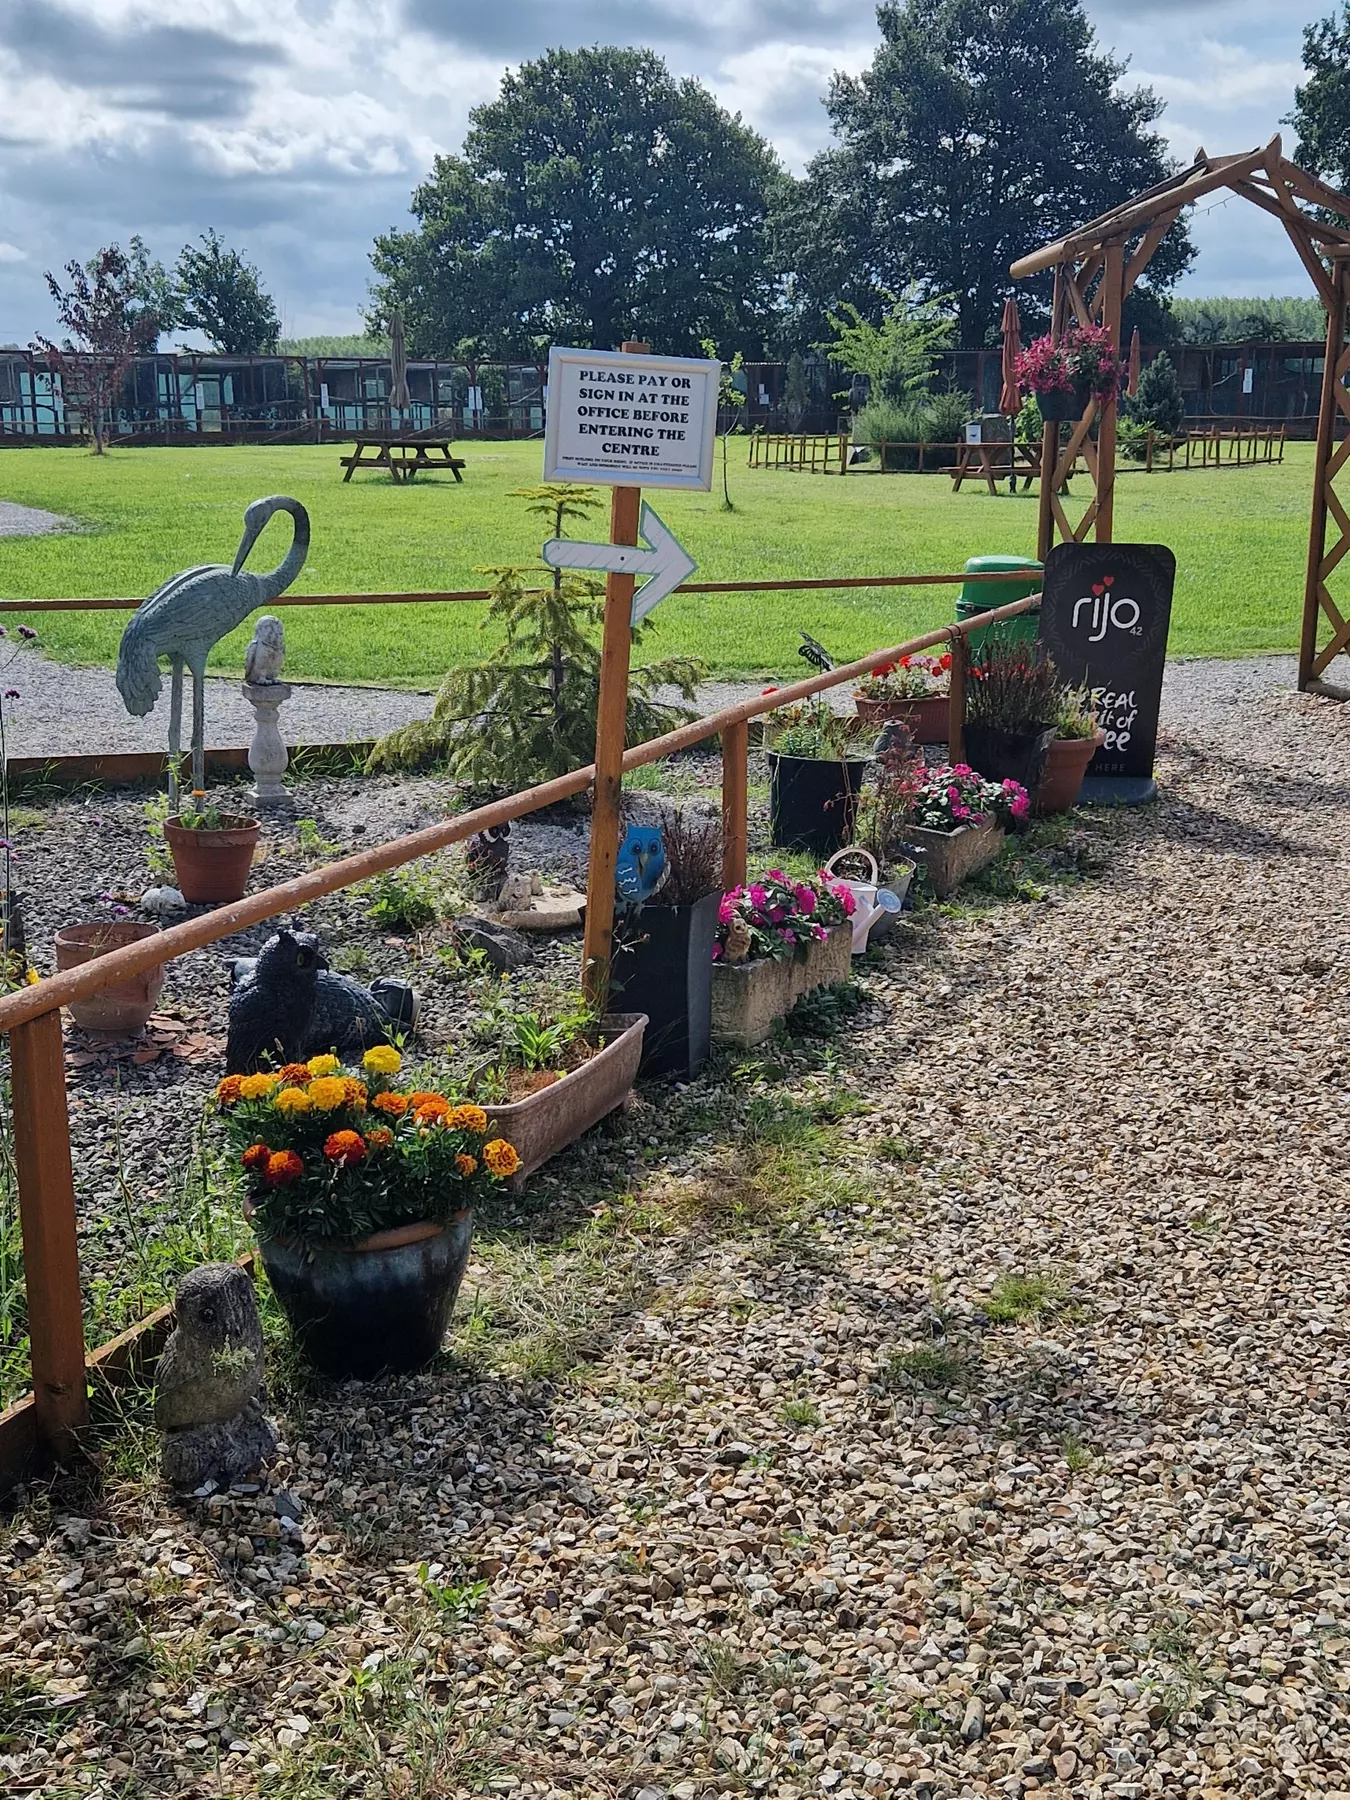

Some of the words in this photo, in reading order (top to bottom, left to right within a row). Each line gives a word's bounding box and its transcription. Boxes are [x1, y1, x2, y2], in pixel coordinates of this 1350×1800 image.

[579, 370, 635, 385] PLEASE
[638, 375, 668, 387] PAY
[671, 377, 691, 389] OR
[579, 388, 615, 401] SIGN
[618, 391, 635, 402] IN
[637, 392, 658, 404] AT
[661, 394, 690, 406] THE
[577, 405, 629, 420] OFFICE
[632, 409, 689, 424] BEFORE
[578, 423, 654, 439] ENTERING
[657, 429, 686, 441] THE
[601, 442, 660, 457] CENTRE
[1129, 626, 1143, 636] 42
[1116, 709, 1138, 731] of
[1094, 763, 1127, 773] HERE
